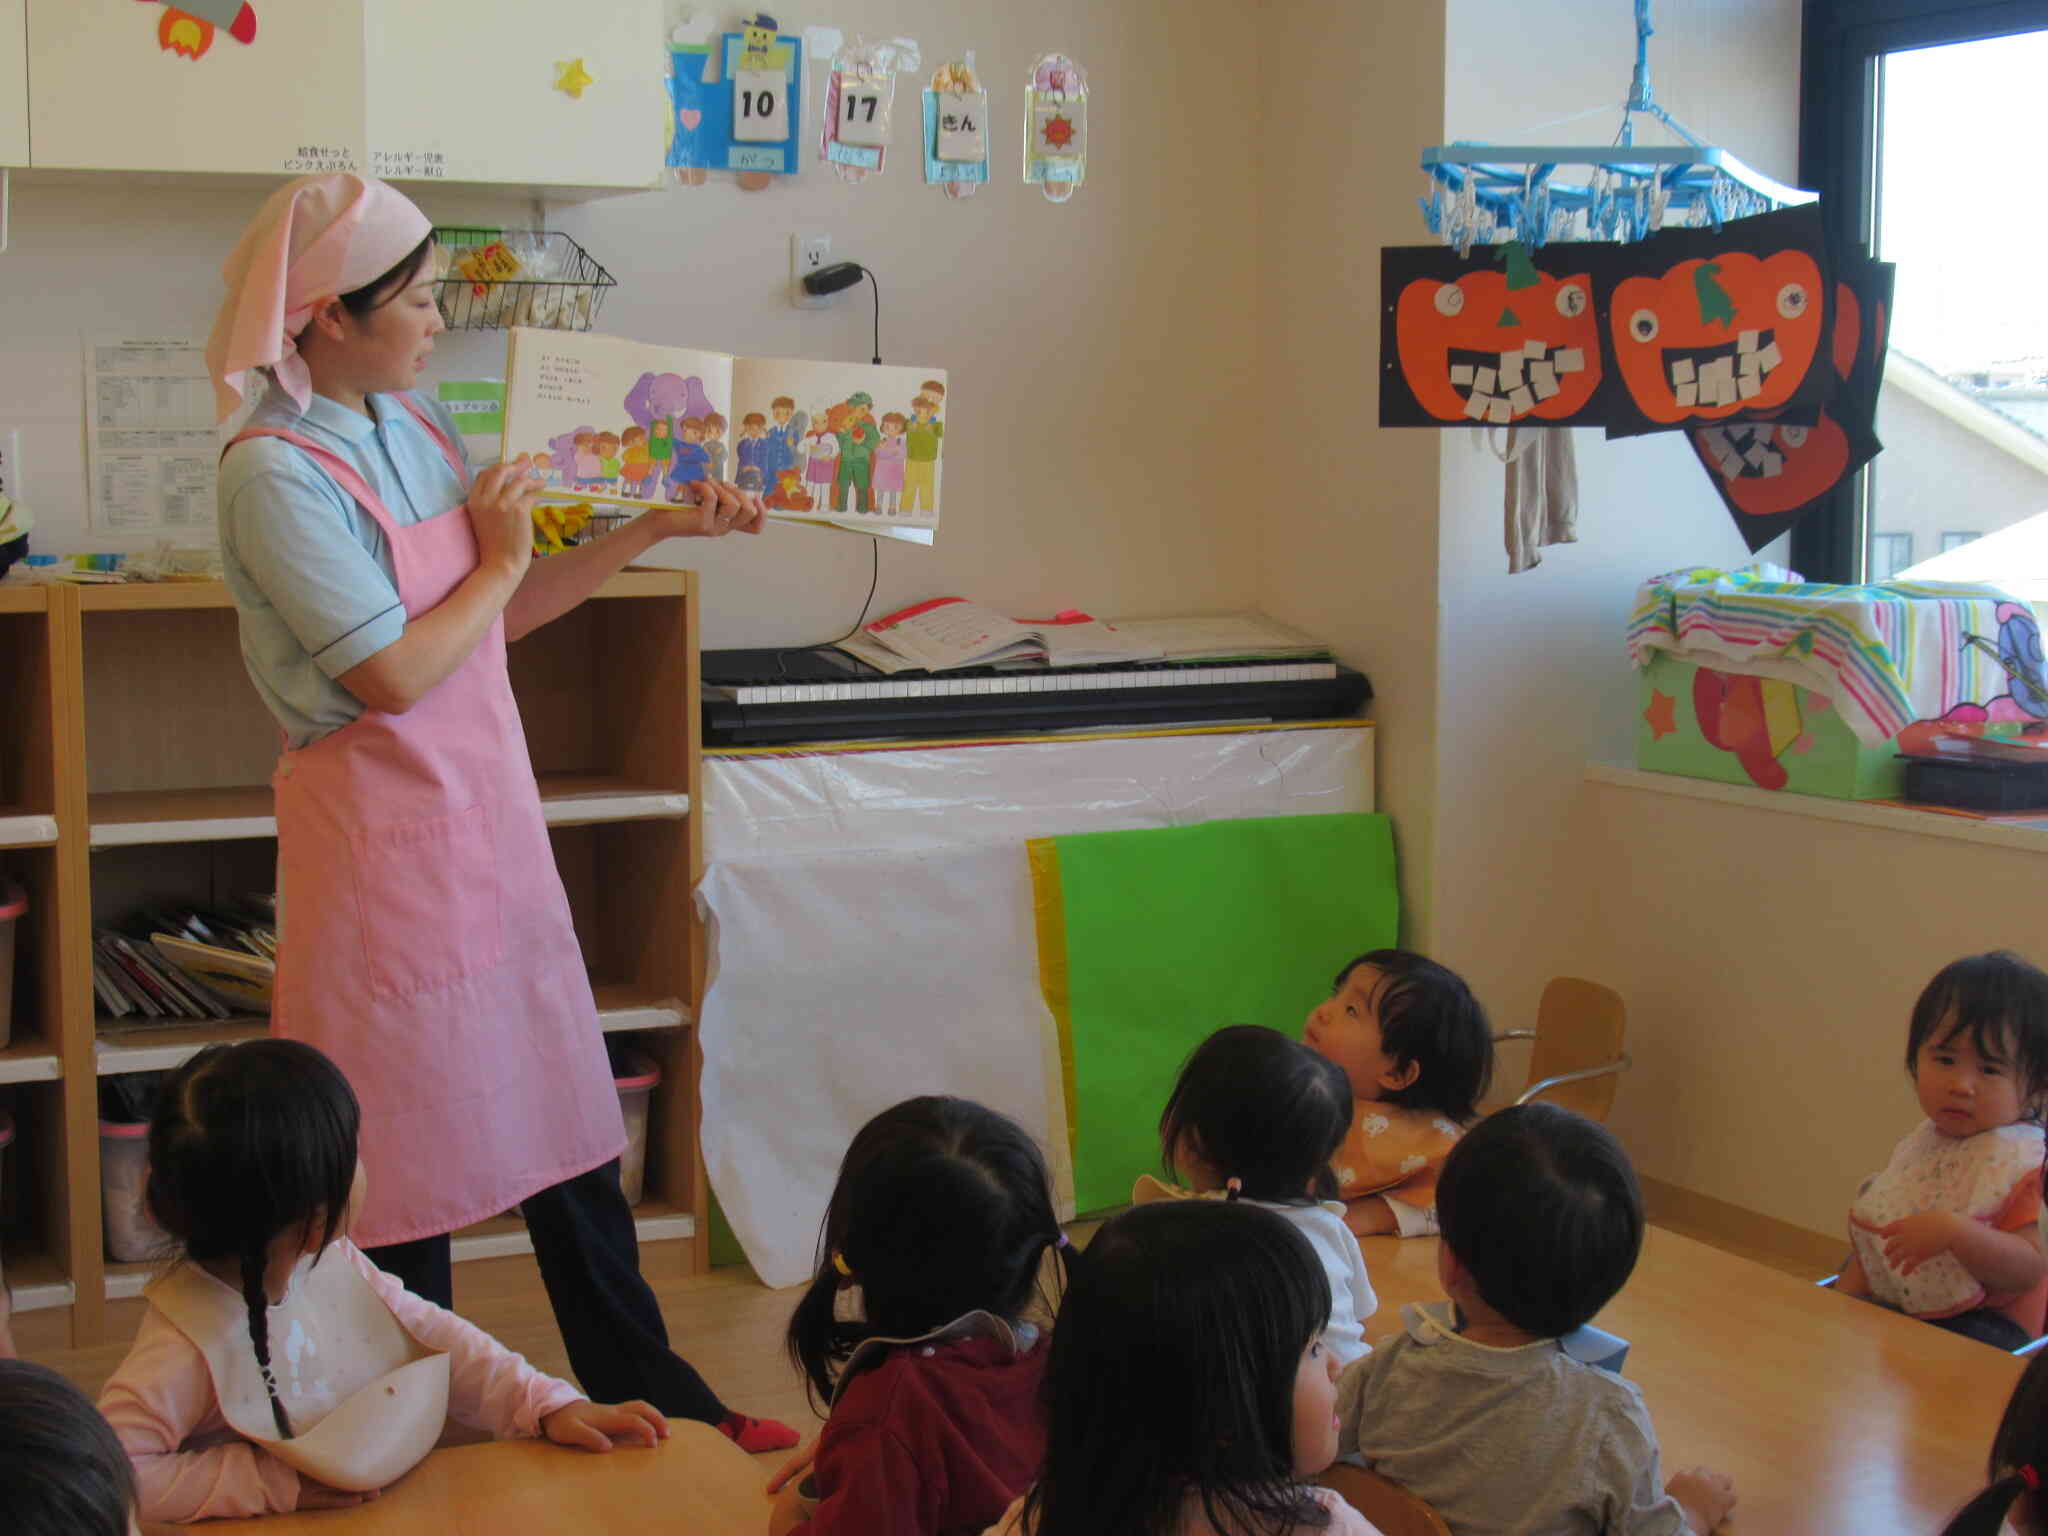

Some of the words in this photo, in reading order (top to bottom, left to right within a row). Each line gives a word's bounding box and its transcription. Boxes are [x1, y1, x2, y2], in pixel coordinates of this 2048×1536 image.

[742, 91, 773, 118] 10
[847, 95, 878, 123] 17
[942, 116, 976, 133] きん
